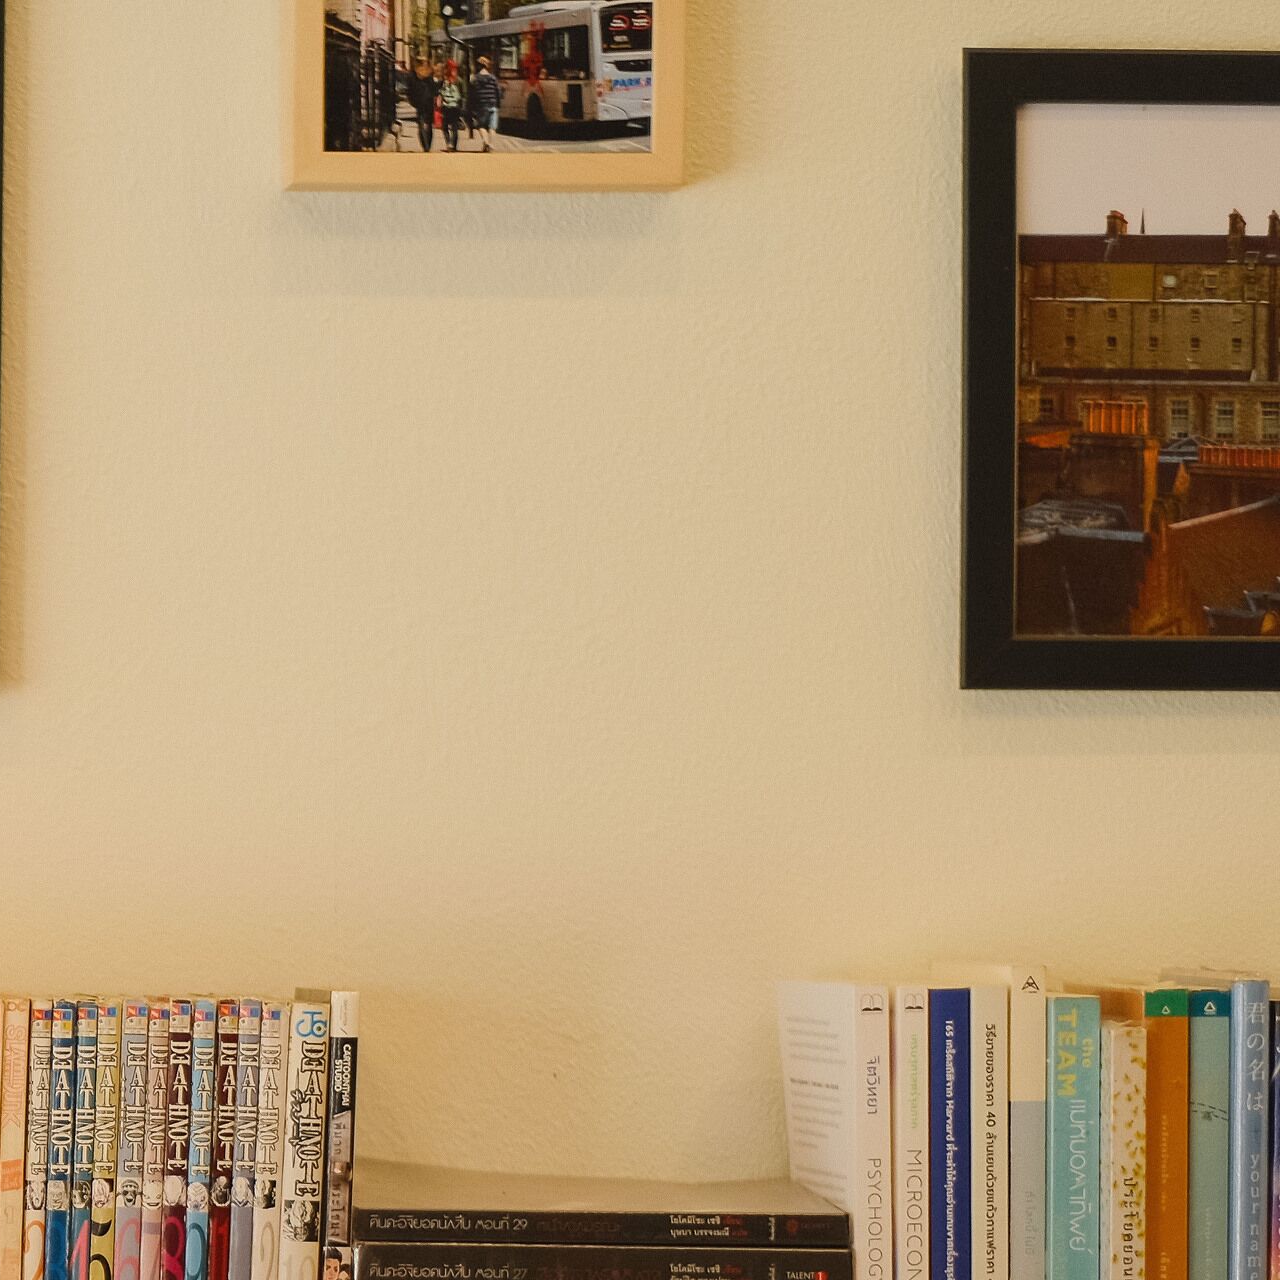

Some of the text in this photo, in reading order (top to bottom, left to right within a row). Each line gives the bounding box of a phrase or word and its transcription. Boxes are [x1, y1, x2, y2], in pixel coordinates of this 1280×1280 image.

[945, 1020, 954, 1037] 165
[1056, 1009, 1077, 1097] TEAM
[1082, 1038, 1094, 1068] the
[1246, 1002, 1266, 1112] 君の名は
[334, 1059, 343, 1093] STUDIO
[341, 1044, 352, 1107] CARTOONTHAI
[945, 1100, 956, 1141] Harvard
[986, 1111, 996, 1127] 40
[1250, 1153, 1260, 1214] your
[512, 1220, 528, 1231] 29
[512, 1269, 528, 1280] 27
[786, 1271, 815, 1280] TALENT
